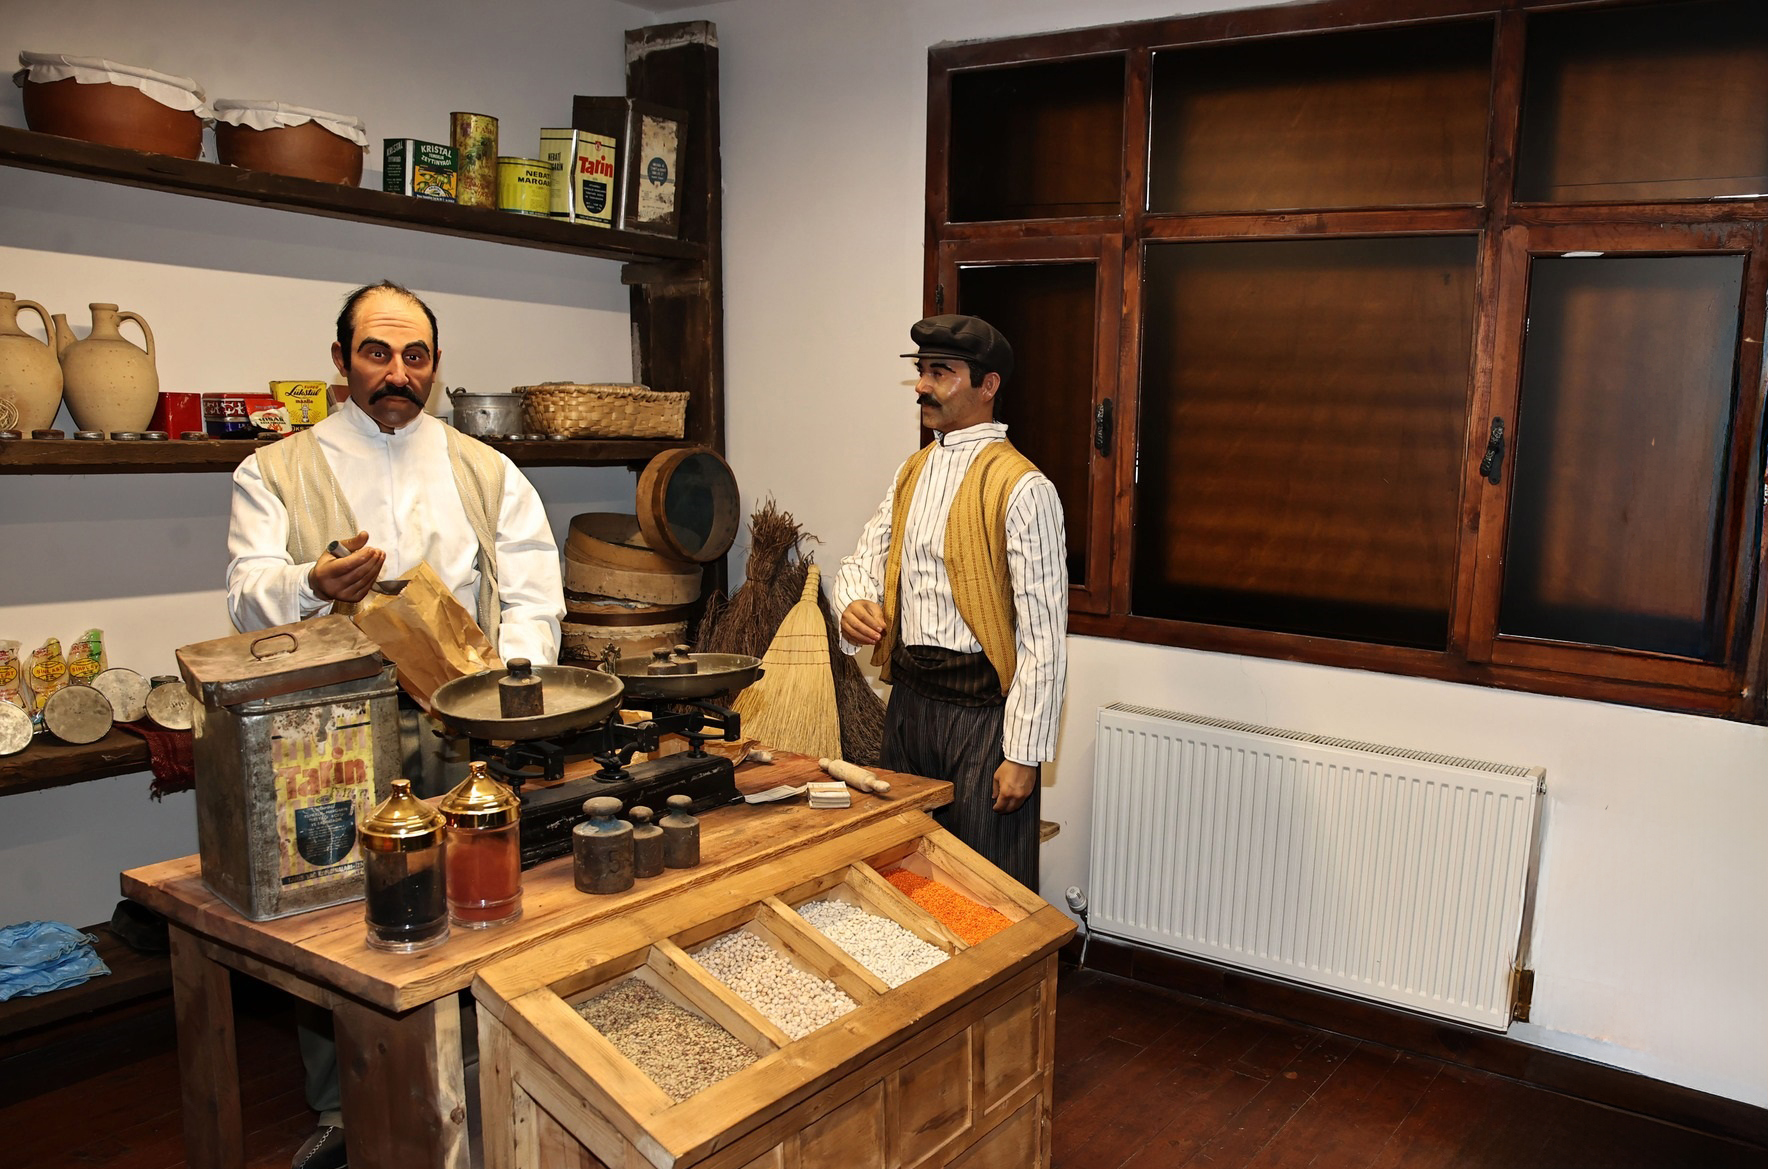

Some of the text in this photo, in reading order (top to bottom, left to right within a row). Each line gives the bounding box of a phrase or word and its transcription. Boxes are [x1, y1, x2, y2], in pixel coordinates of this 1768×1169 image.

[421, 145, 452, 158] KRISTAL
[578, 155, 614, 178] Tarin
[274, 746, 366, 800] Tarin
